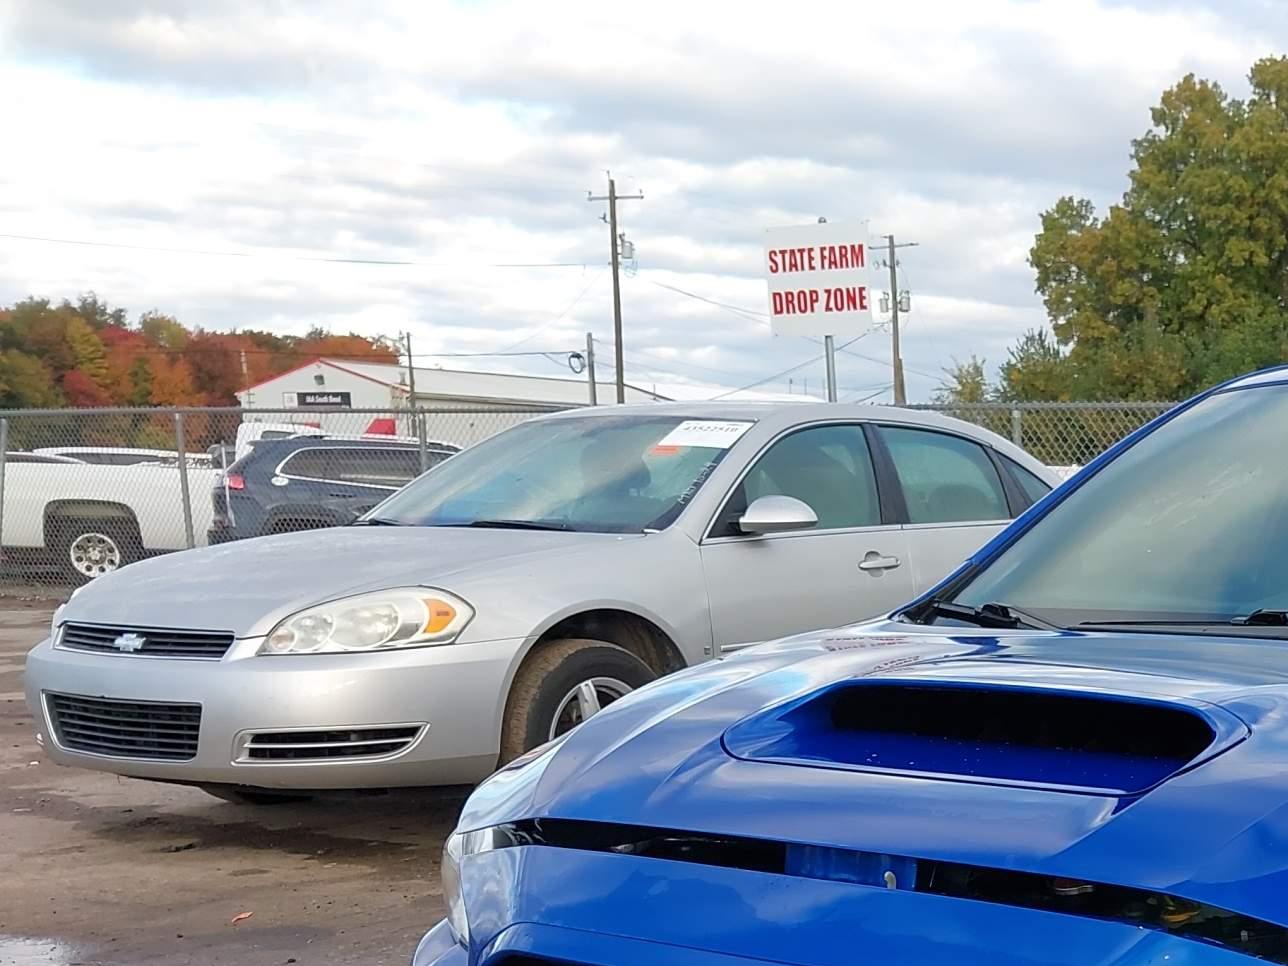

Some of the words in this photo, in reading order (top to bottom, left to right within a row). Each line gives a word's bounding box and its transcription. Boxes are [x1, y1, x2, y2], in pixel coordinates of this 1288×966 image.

[768, 247, 816, 274] STATE
[819, 243, 865, 270] FARM
[772, 289, 819, 315] DROP
[824, 286, 868, 312] ZONE
